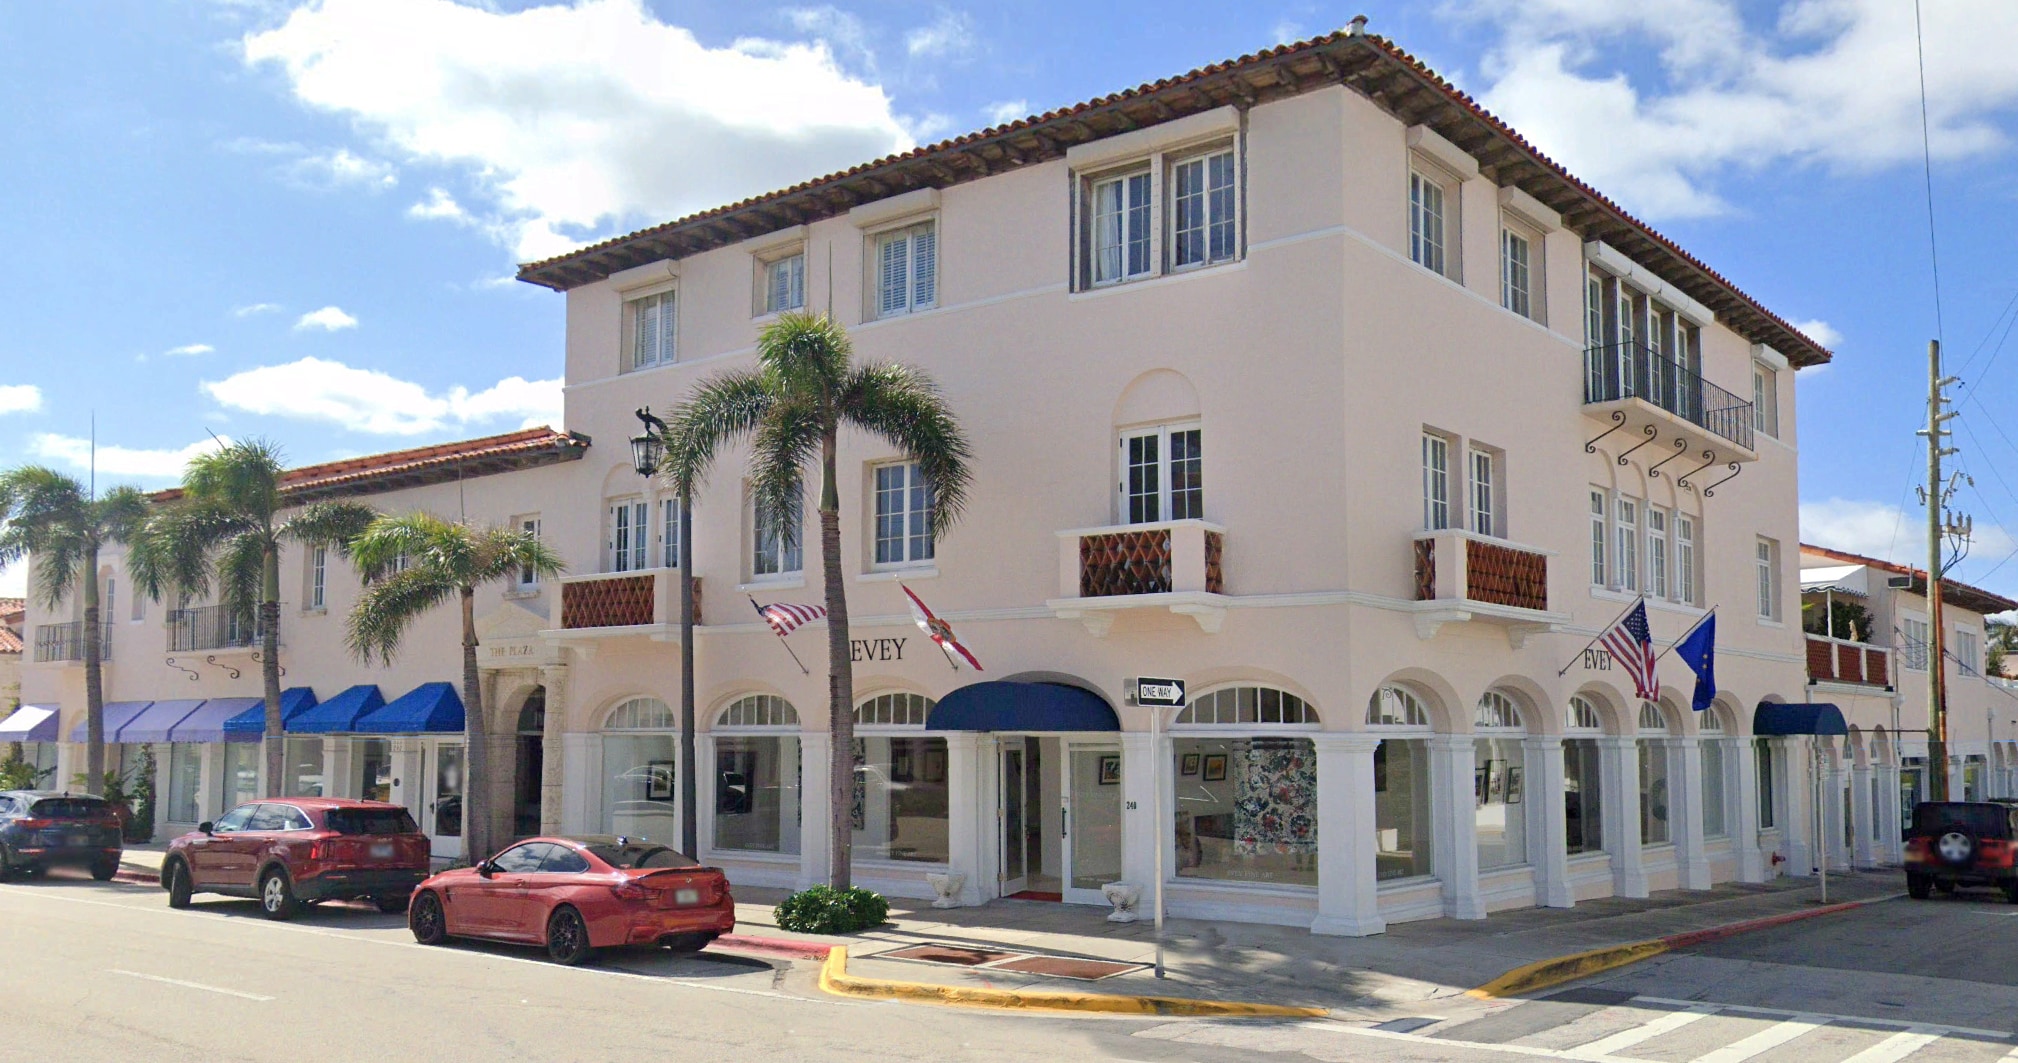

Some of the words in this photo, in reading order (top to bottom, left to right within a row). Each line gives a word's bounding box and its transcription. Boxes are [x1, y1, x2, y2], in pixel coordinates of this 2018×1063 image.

[851, 638, 907, 661] EVEY
[1584, 649, 1612, 670] EVEY
[1142, 686, 1156, 697] ONE
[1158, 687, 1172, 698] WAY
